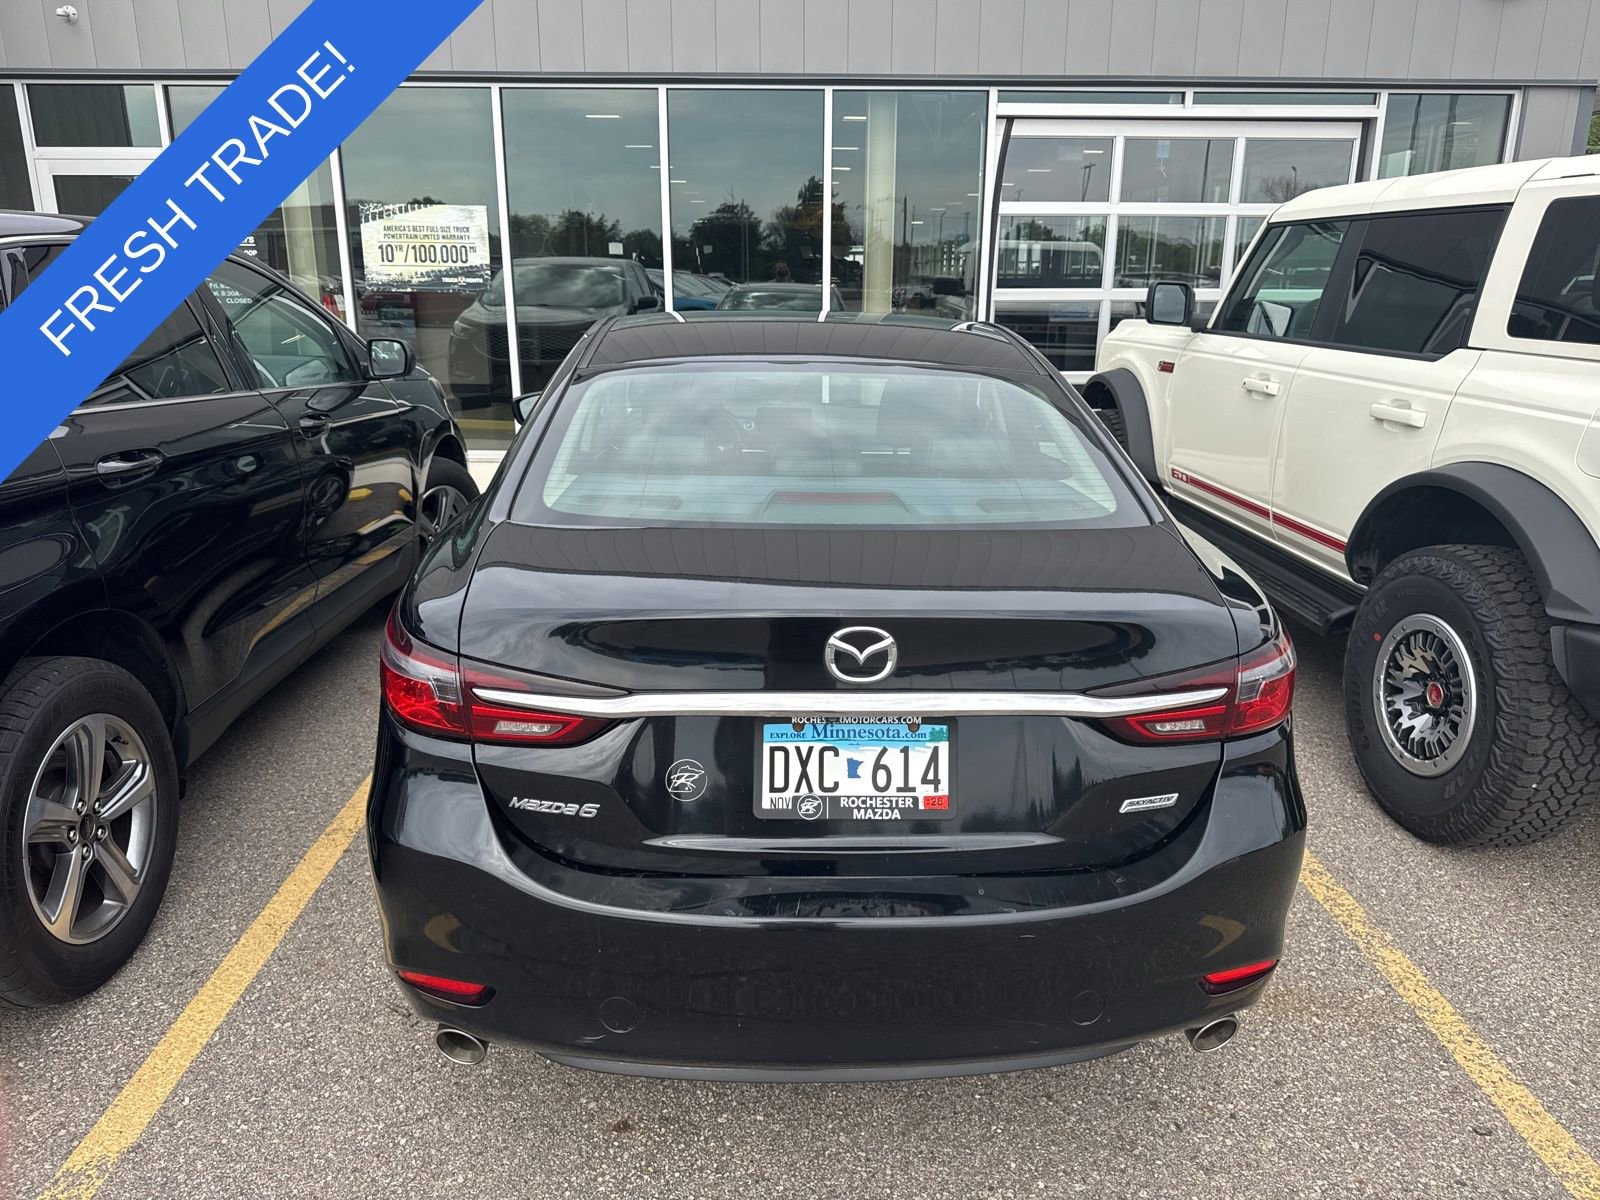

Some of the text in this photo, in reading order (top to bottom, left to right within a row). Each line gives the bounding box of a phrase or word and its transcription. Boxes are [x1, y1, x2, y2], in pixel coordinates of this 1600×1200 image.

[791, 716, 922, 724] ROCHESRMOTORCARS.COM
[769, 745, 941, 793] DXC 614
[770, 797, 791, 809] NOV
[840, 796, 914, 808] ROCHESTER
[1128, 795, 1175, 806] SKYACTIV
[853, 808, 901, 820] MAZDA
